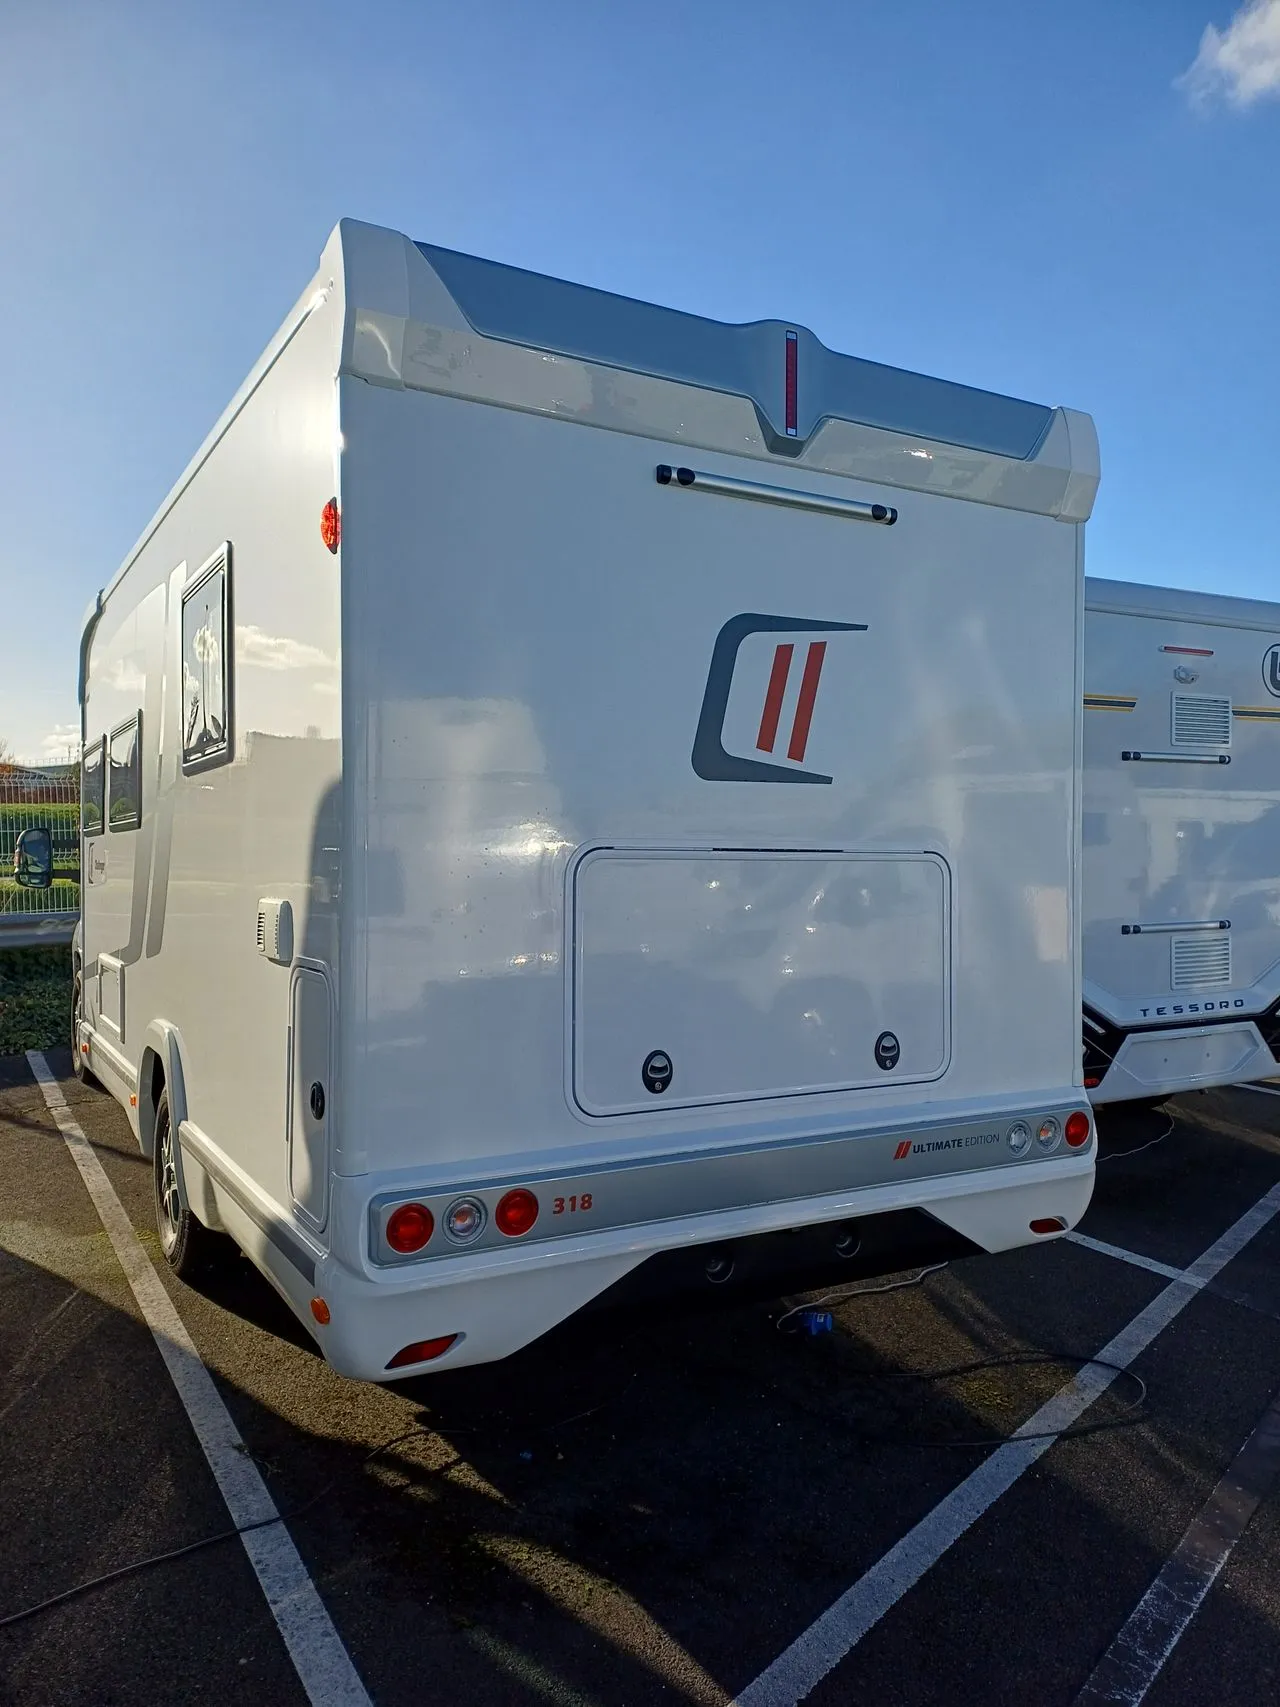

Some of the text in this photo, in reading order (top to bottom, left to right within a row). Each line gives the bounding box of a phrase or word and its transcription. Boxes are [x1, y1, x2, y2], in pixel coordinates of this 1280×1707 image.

[1140, 999, 1244, 1017] TESSORO
[912, 1133, 1000, 1154] ULTIMATE EDITION
[552, 1193, 593, 1214] 318
